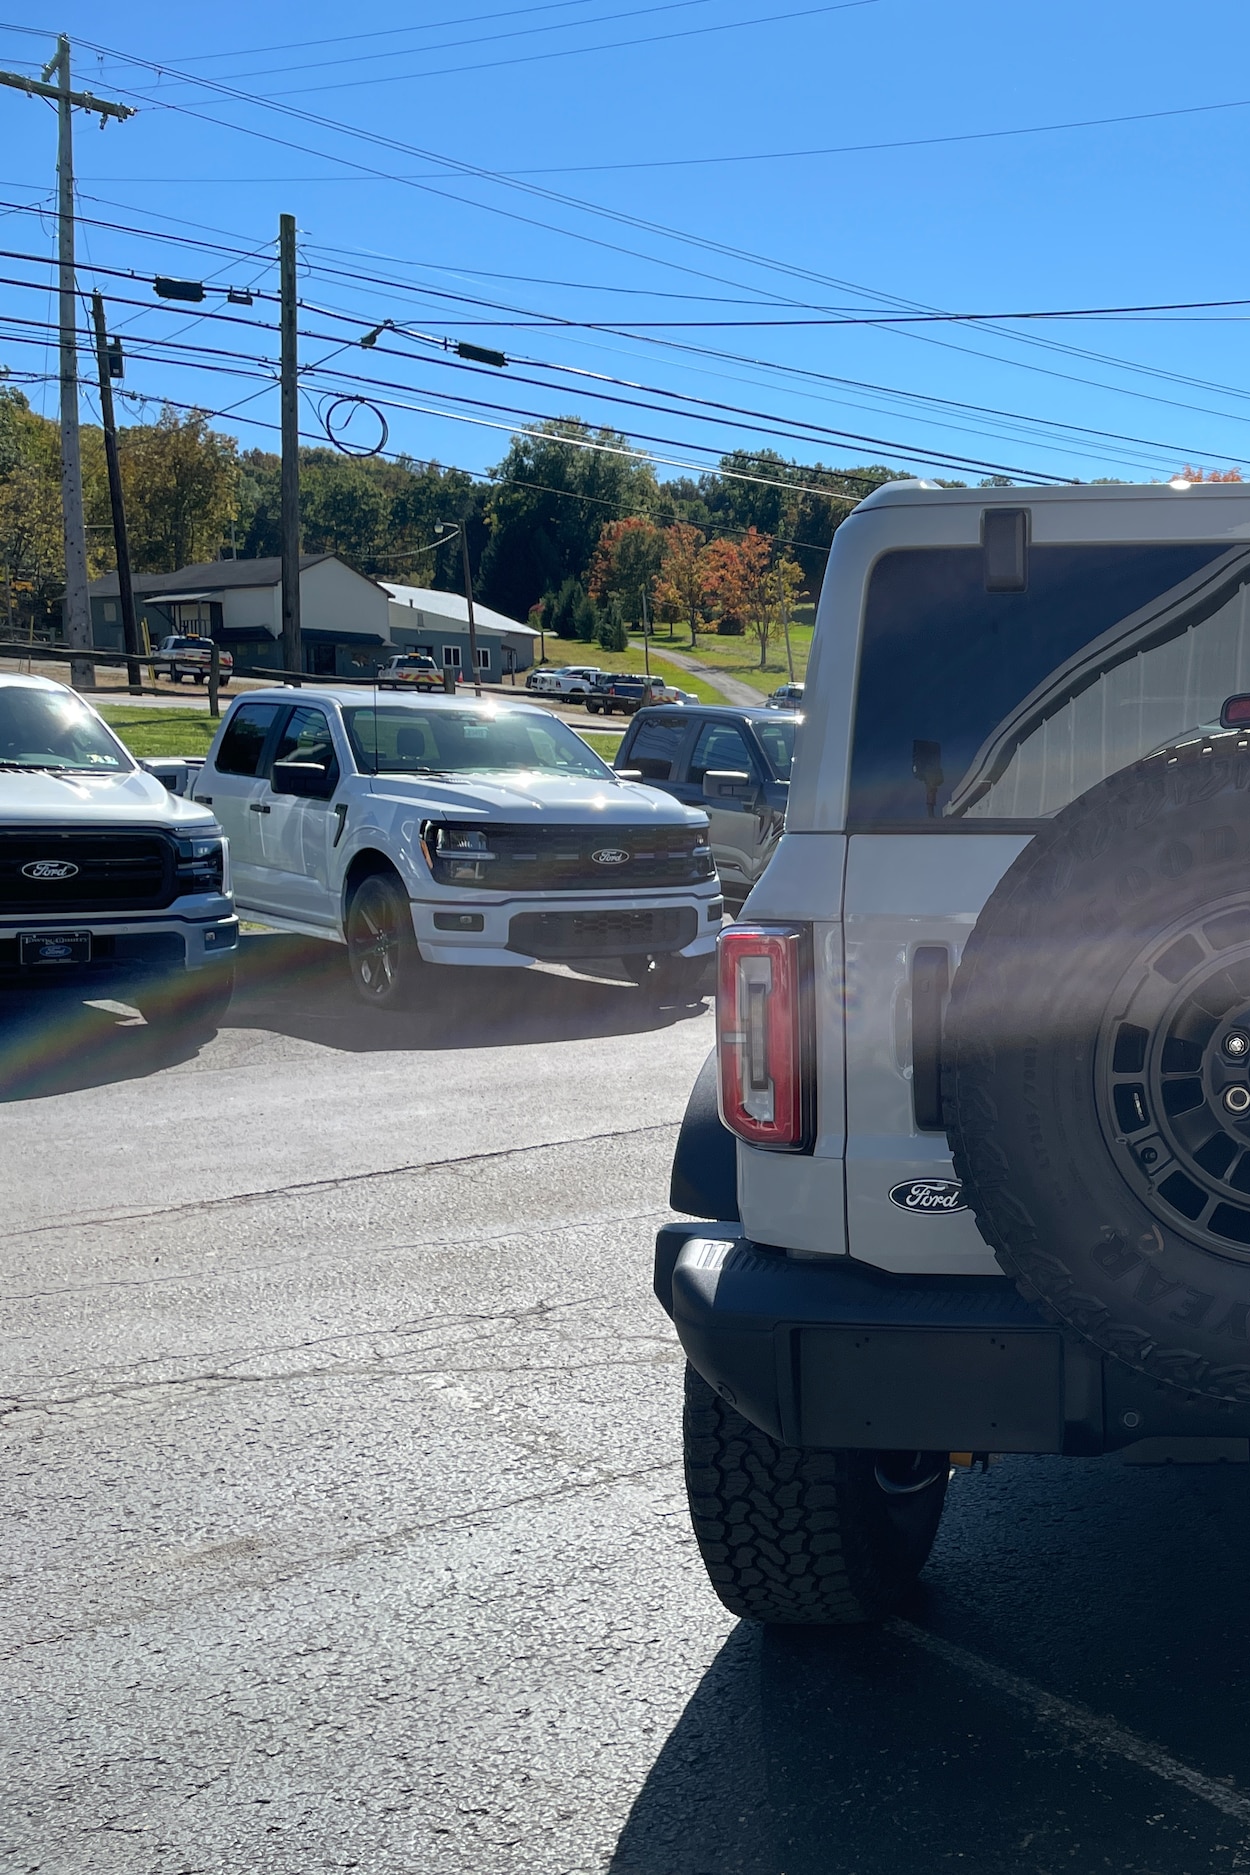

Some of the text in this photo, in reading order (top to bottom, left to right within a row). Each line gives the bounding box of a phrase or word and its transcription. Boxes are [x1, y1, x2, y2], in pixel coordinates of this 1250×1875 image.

[599, 849, 623, 862] Ford
[33, 863, 68, 876] Ford
[905, 1184, 960, 1207] Ford
